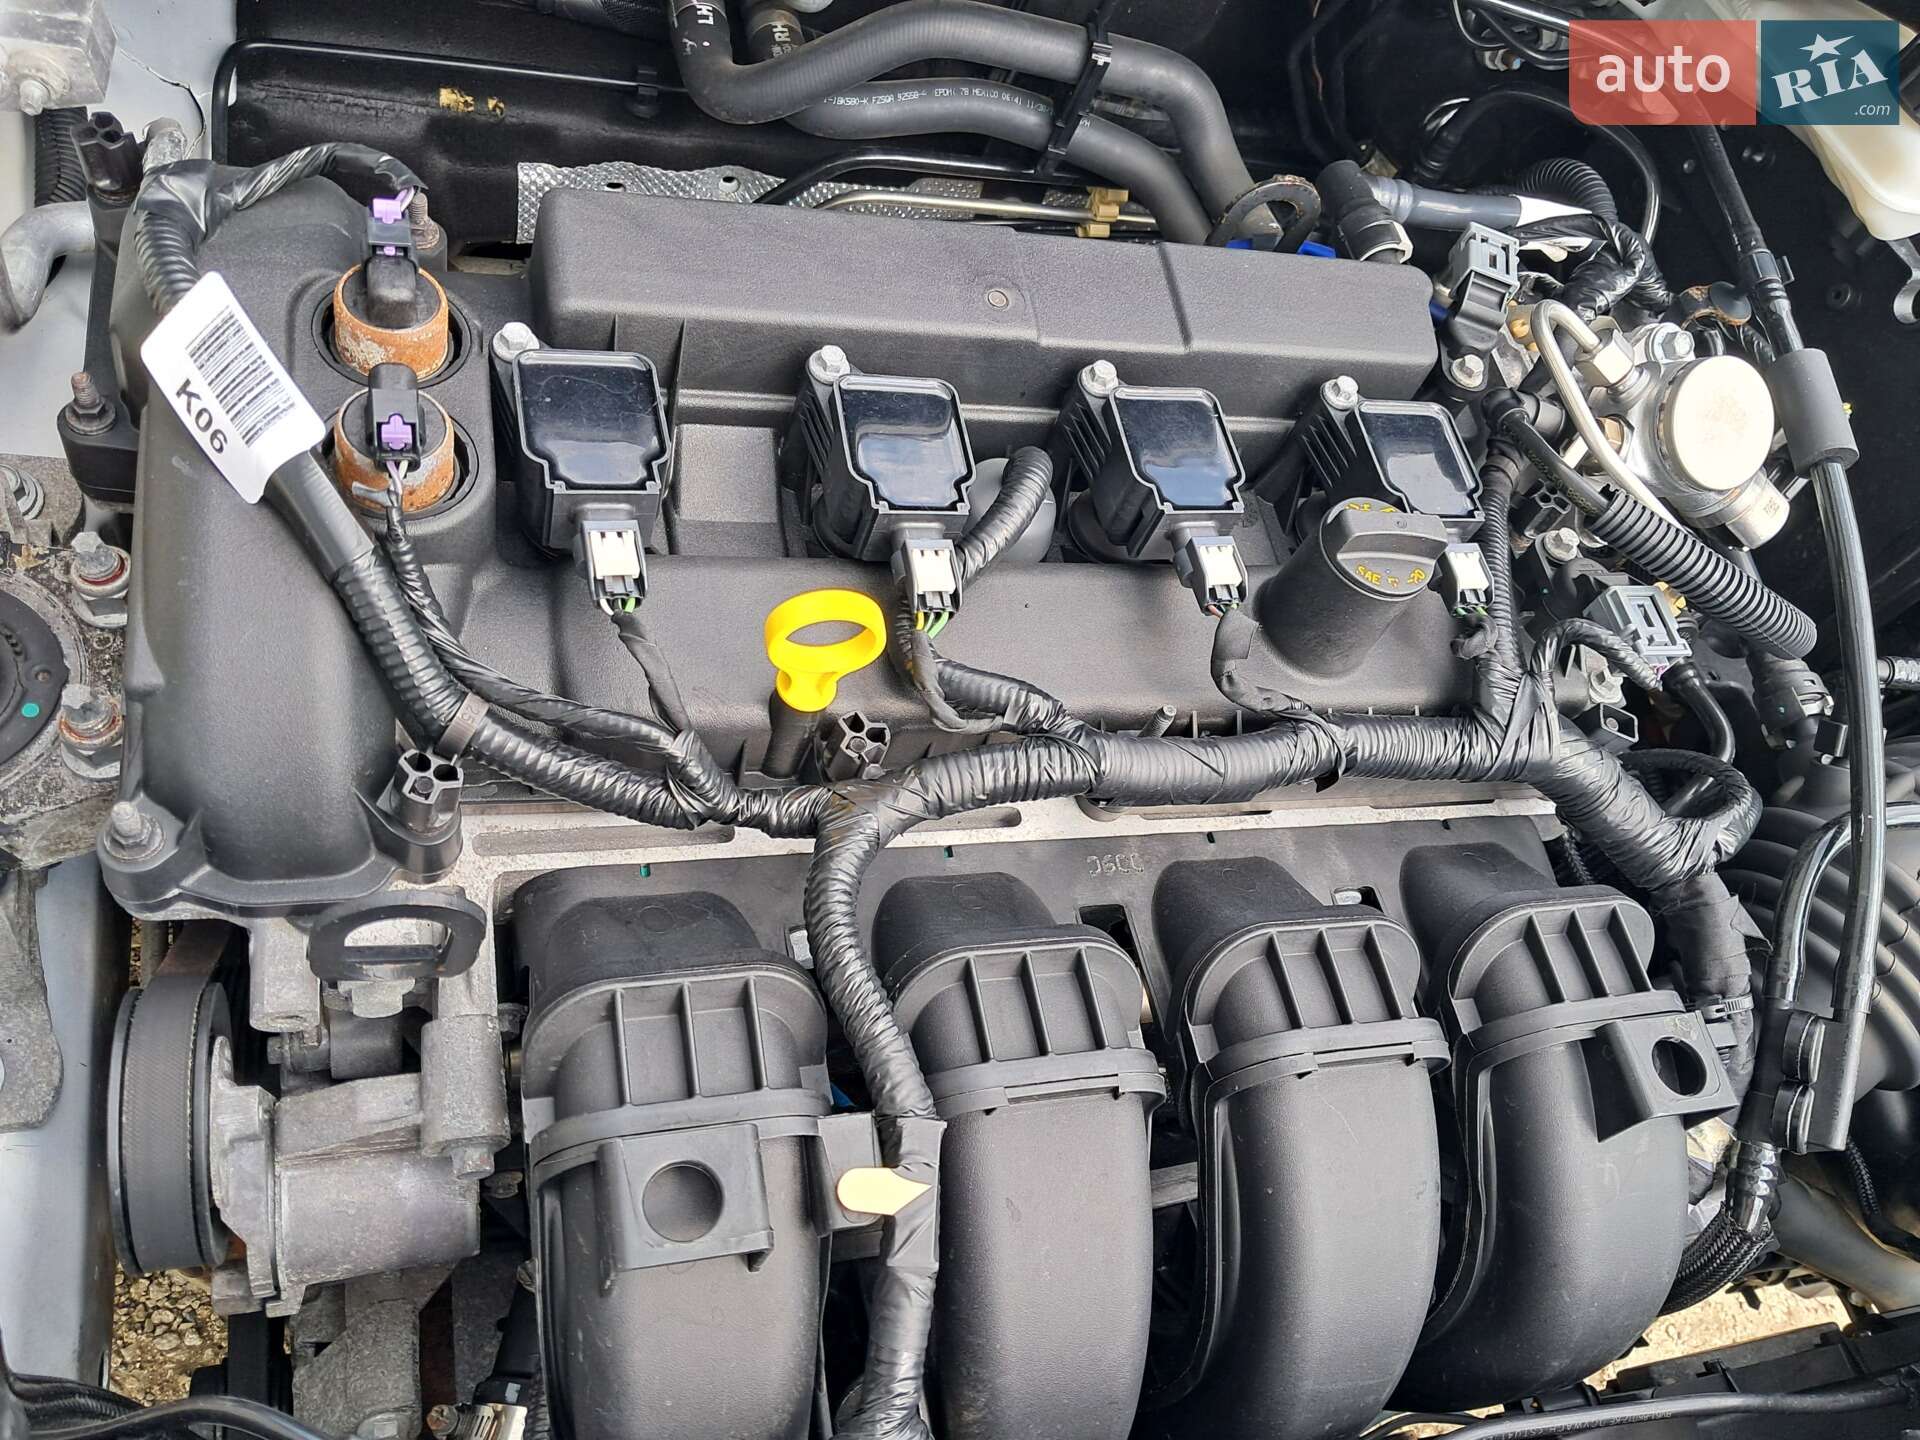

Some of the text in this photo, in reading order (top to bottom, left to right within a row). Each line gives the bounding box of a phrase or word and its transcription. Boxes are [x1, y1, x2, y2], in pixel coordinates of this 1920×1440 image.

[696, 3, 714, 25] LH
[771, 22, 792, 42] RH
[176, 378, 228, 454] K06
[1356, 565, 1382, 586] SAE
